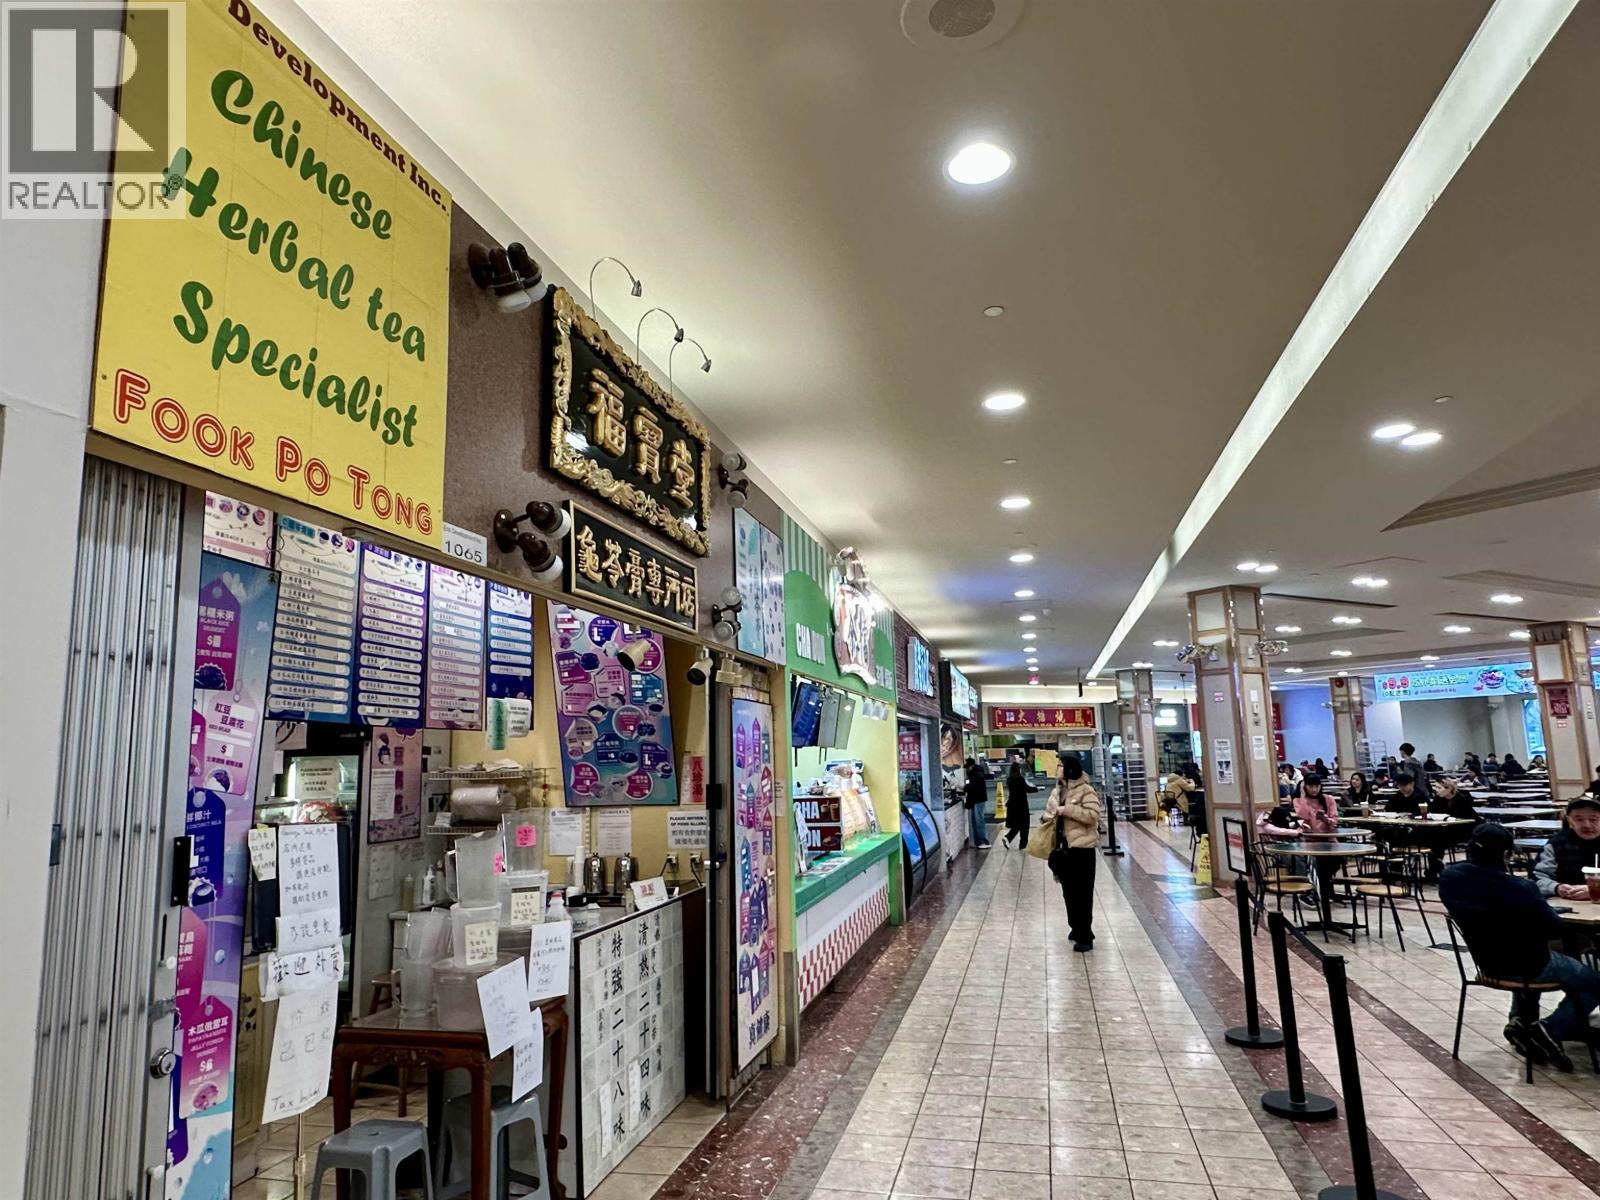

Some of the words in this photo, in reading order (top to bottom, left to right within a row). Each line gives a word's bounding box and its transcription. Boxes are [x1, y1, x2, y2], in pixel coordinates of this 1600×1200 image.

[211, 69, 392, 240] Chinese
[228, 0, 406, 173] Development
[409, 164, 450, 217] Inc.
[162, 147, 354, 310] Herbal
[367, 287, 426, 362] tea
[173, 280, 418, 448] Specialist
[113, 367, 255, 471] FOOK
[275, 435, 331, 497] PO
[346, 464, 433, 536] TONG
[445, 540, 482, 563] 1065
